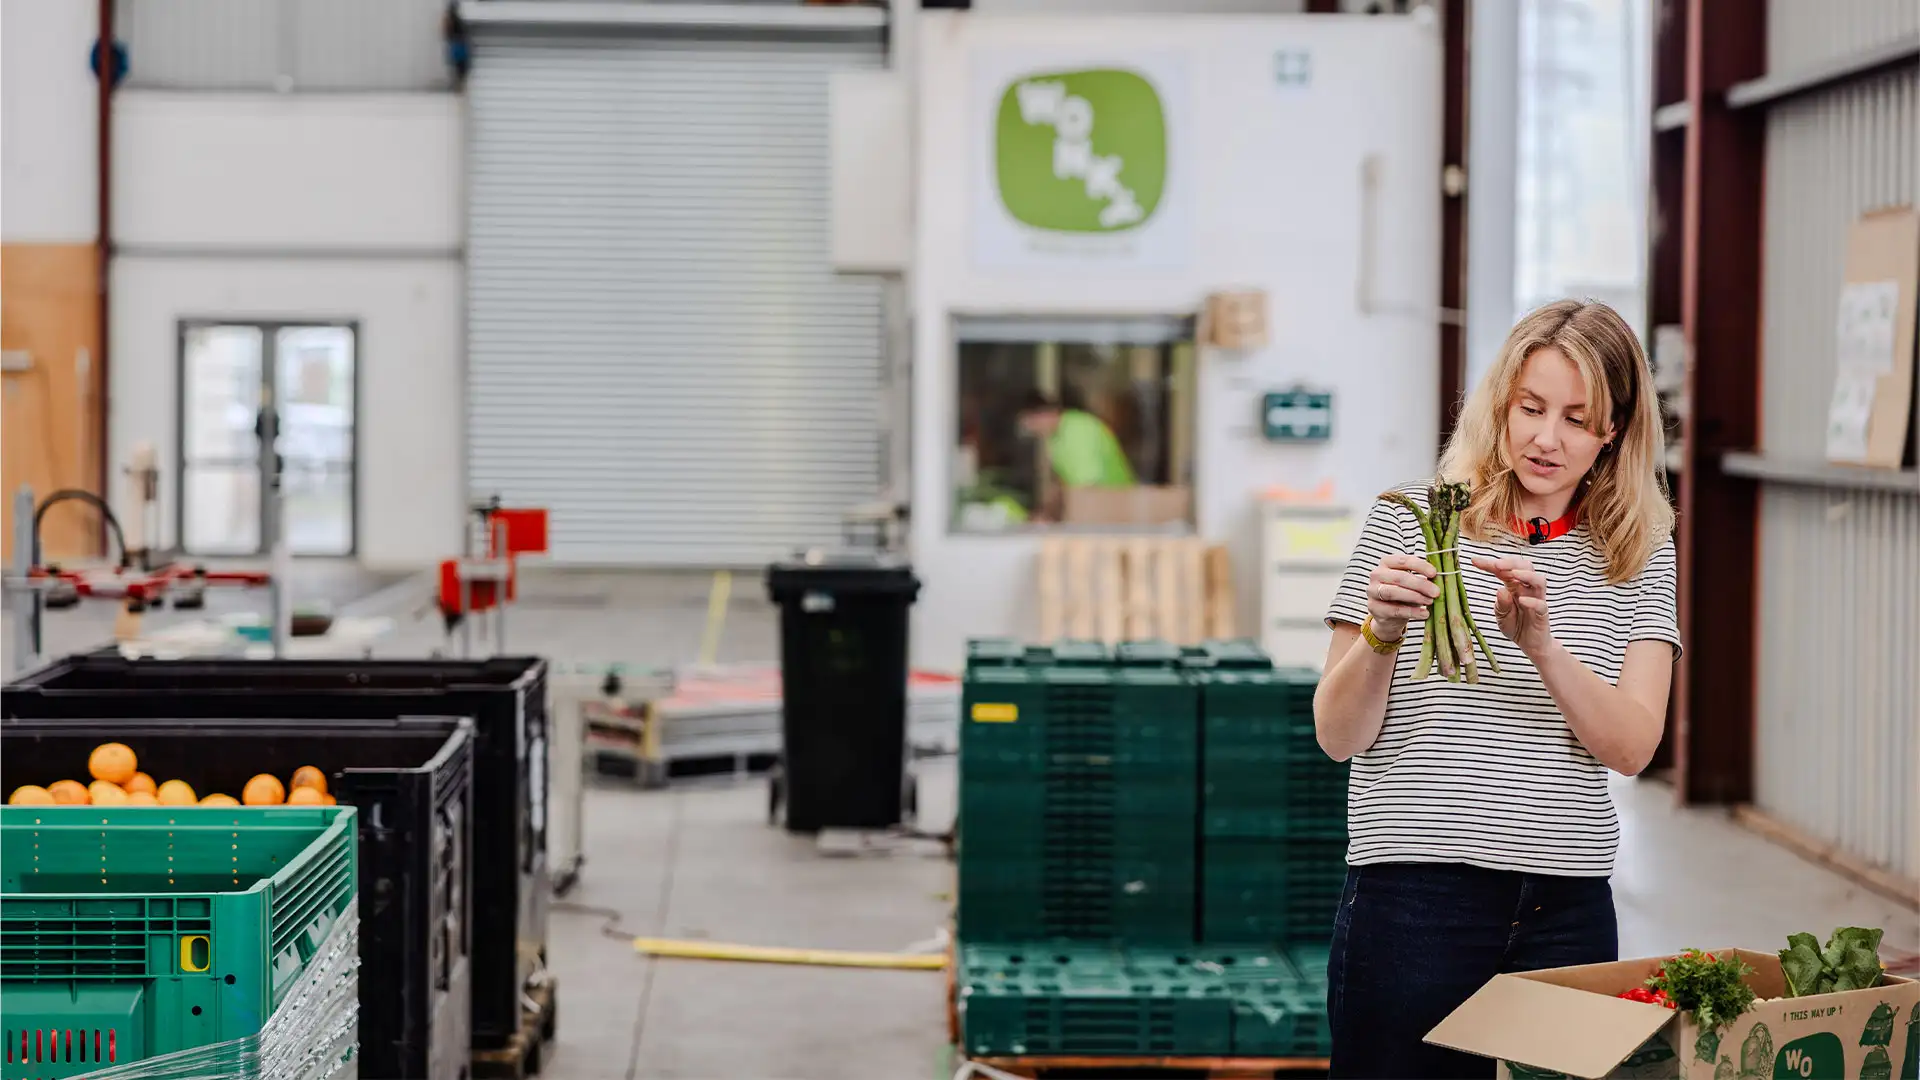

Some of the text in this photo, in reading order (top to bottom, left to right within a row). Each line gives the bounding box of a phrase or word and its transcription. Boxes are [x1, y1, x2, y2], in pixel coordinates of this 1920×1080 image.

[1790, 1006, 1836, 1021] THIS WAY UP
